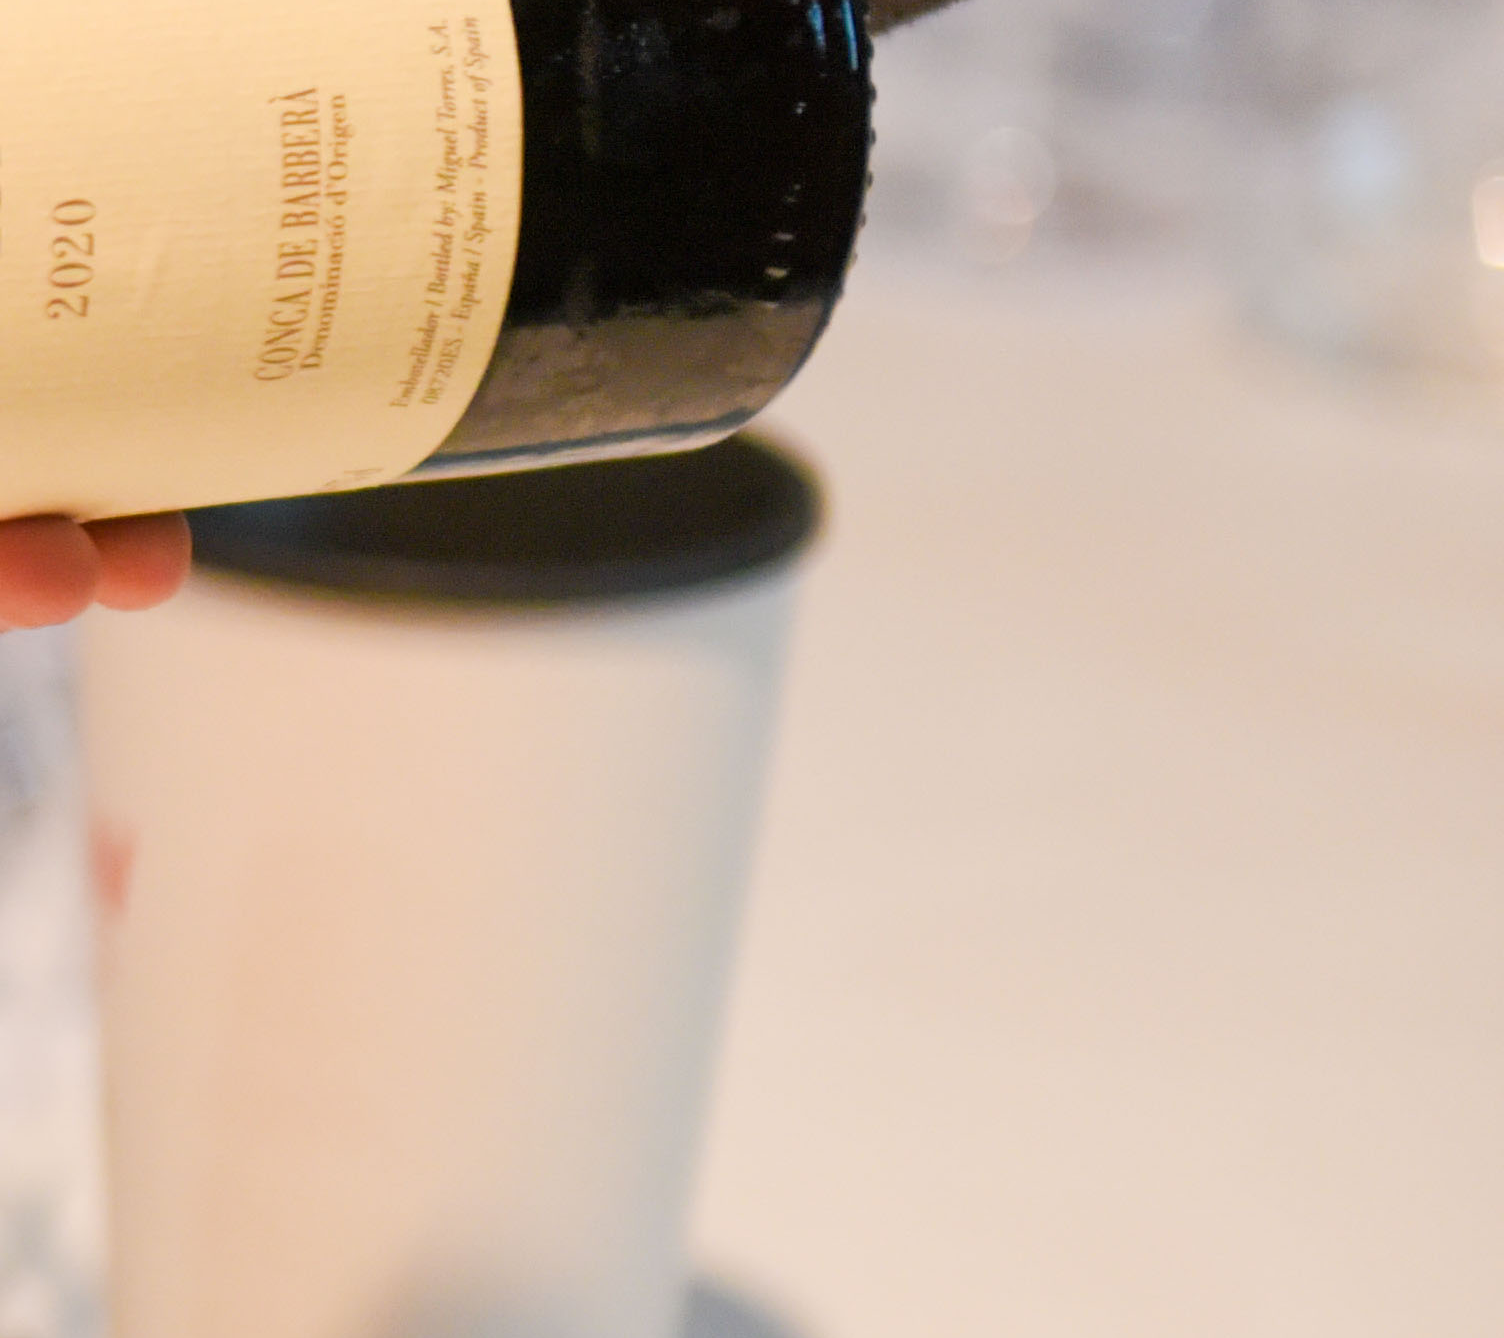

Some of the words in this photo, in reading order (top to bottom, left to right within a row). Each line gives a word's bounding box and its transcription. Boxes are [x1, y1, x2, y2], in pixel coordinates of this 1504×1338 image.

[462, 16, 492, 69] Spain
[266, 86, 321, 229] BARBERÀ
[433, 126, 464, 193] Miguel
[466, 97, 489, 169] Product
[463, 190, 492, 244] Spain
[45, 198, 96, 320] 2020
[274, 238, 320, 280] DE
[299, 214, 347, 370] Denominació
[426, 231, 455, 294] Bottled
[449, 259, 482, 320] España
[252, 289, 313, 382] CONCA
